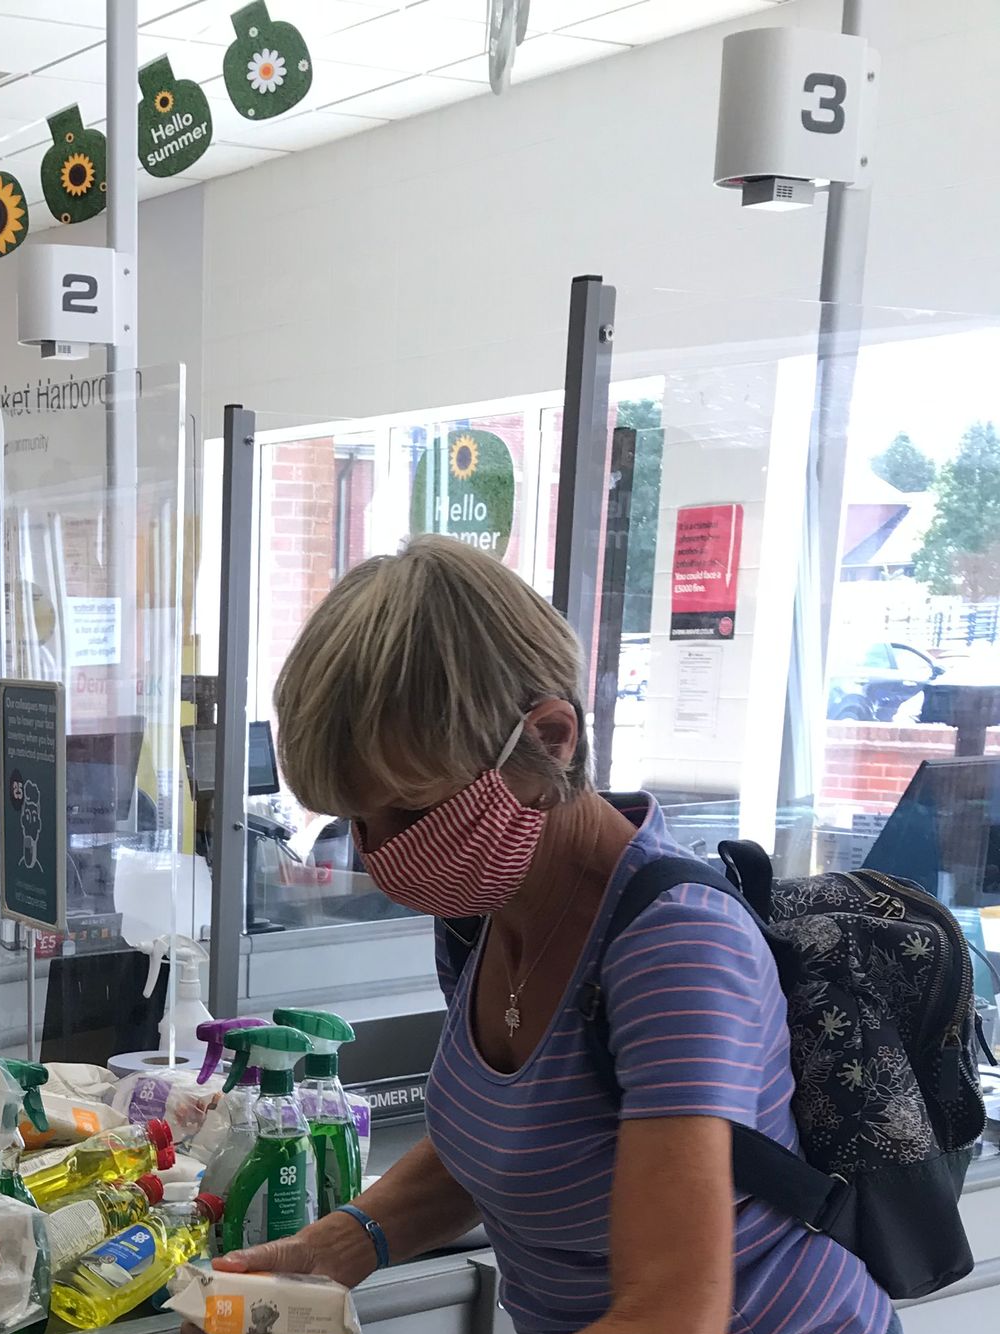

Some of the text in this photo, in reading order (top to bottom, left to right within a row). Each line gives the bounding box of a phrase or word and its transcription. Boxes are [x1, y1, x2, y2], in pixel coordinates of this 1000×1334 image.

[801, 72, 847, 135] 3
[146, 121, 208, 167] summer
[151, 112, 194, 144] Hello
[62, 273, 98, 314] 2
[40, 934, 56, 950] £5
